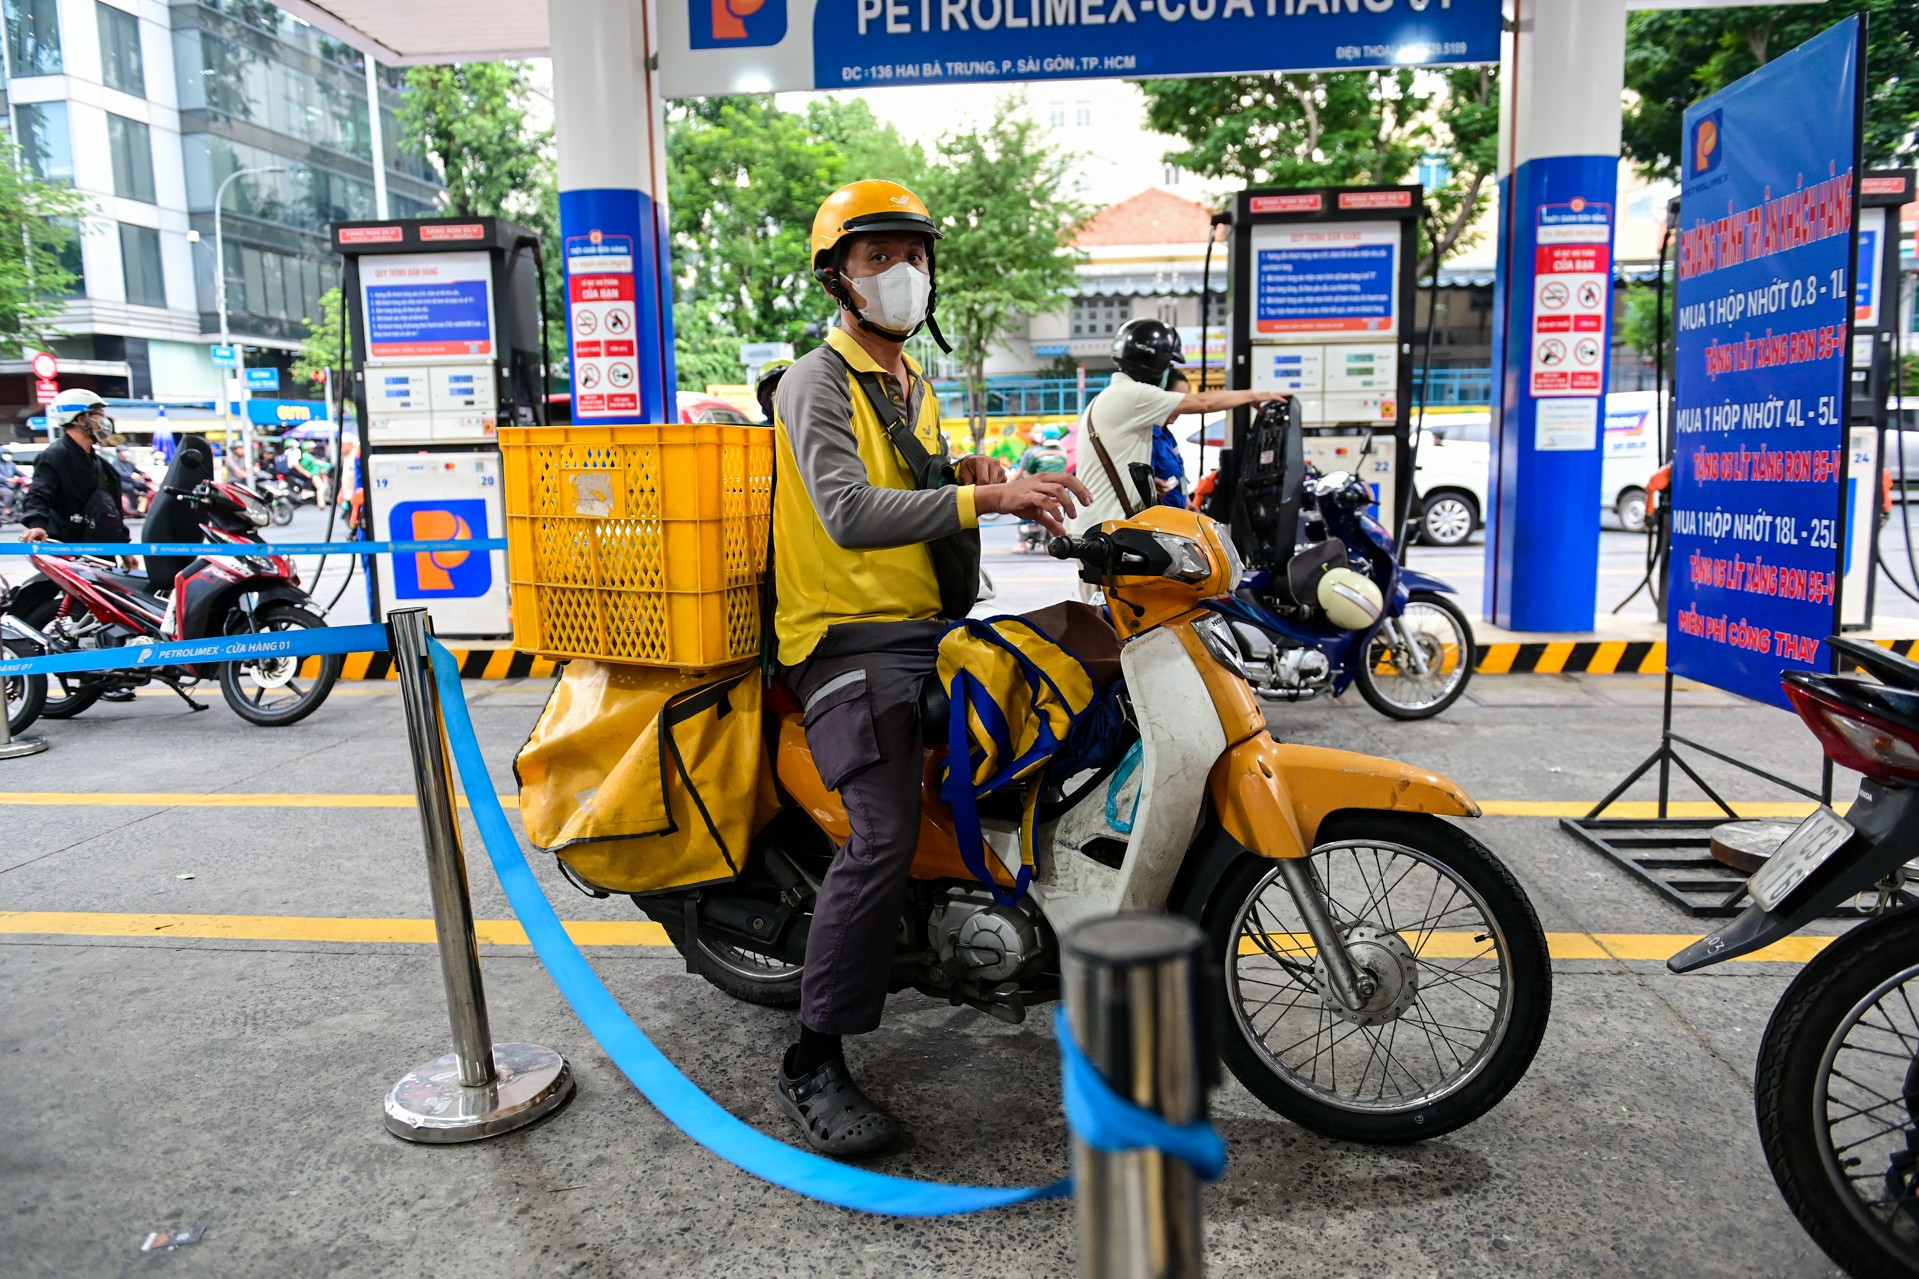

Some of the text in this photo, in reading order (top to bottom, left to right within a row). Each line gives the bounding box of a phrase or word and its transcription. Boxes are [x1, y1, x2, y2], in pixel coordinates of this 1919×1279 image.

[895, 64, 920, 78] HAI
[922, 59, 943, 76] BÀ
[1017, 55, 1041, 72] SÀI
[1780, 171, 1819, 252] KHÁCH
[1817, 158, 1853, 241] HÀNG
[582, 287, 619, 300] CỦA BẠN
[1680, 302, 1706, 331] MUA
[1708, 300, 1715, 325] 1
[1716, 288, 1745, 329] HỘP
[1746, 277, 1789, 318] NHỚT
[1791, 275, 1817, 309] 0.8
[1830, 268, 1847, 300] 1L
[1705, 337, 1732, 382] TẶNG
[1755, 327, 1789, 369] XĂNG
[1789, 328, 1818, 364] RON
[1676, 407, 1702, 433] MUA
[1703, 406, 1710, 432] 1
[1711, 398, 1741, 437] HỘP
[1741, 393, 1784, 430] NHỚT
[1785, 399, 1805, 427] 4L
[1818, 395, 1839, 426] 5L
[1374, 461, 1390, 472] 22
[1693, 444, 1719, 488] TẶNG
[1720, 452, 1734, 481] 03
[1733, 443, 1750, 481] LÍT
[1750, 442, 1784, 482] XĂNG
[1784, 450, 1812, 482] RON
[1854, 452, 1870, 464] 24
[375, 478, 389, 489] 19
[481, 476, 495, 487] 20
[1673, 509, 1697, 536] MUA
[1698, 511, 1703, 535] 1
[1704, 505, 1733, 544] HỘP
[1733, 507, 1773, 542] NHỚT
[1775, 516, 1798, 545] 18L
[1810, 518, 1838, 549] 25L
[1690, 548, 1713, 590] TẶNG
[1713, 558, 1727, 588] 05
[1726, 552, 1746, 590] LÍT
[1744, 555, 1778, 596] XĂNG
[1778, 566, 1807, 600] RON
[1678, 601, 1820, 665] MIỄN PHÍ CÔNG THAY
[21, 662, 33, 671] 01
[158, 646, 219, 660] PETROLIMEX
[226, 642, 248, 655] CỬA
[248, 640, 279, 654] HÀNG
[279, 640, 292, 651] 01
